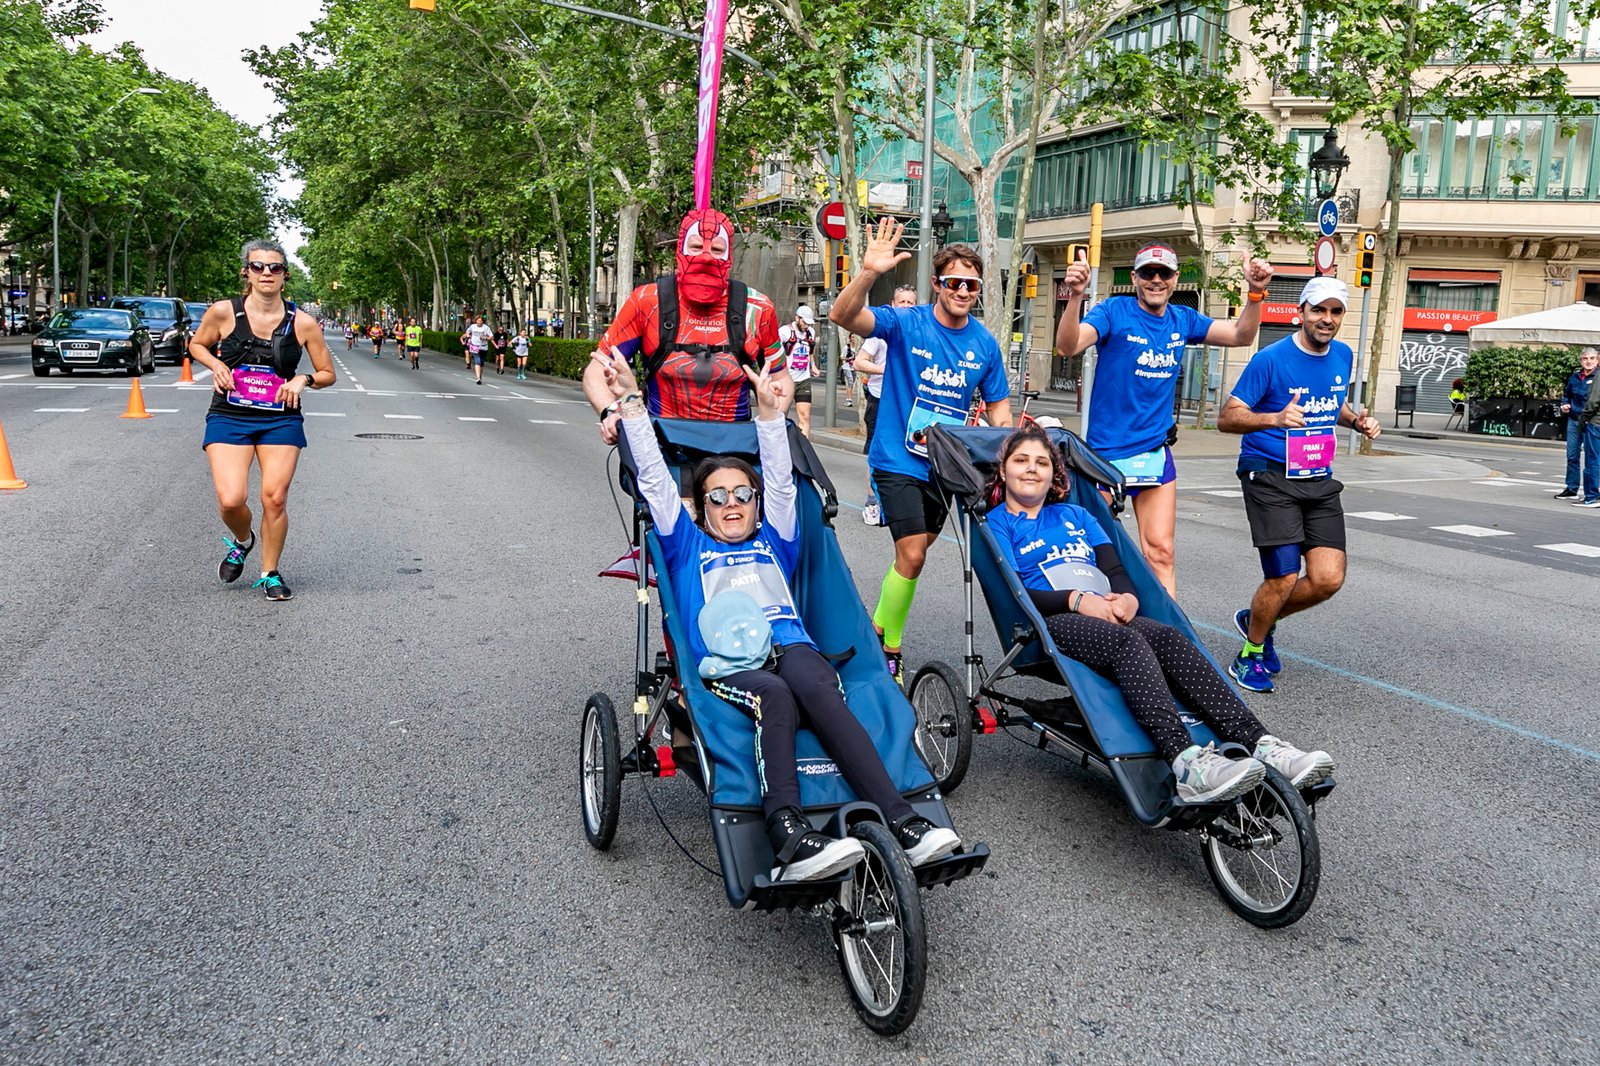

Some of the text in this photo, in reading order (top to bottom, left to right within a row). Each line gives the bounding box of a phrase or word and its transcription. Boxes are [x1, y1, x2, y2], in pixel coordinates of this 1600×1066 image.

[1267, 306, 1298, 314] PASSION
[1416, 311, 1451, 320] PASSION
[243, 377, 272, 386] MONICA
[918, 383, 962, 400] #imparables
[1303, 443, 1320, 452] FRAN
[1306, 453, 1322, 462] 1015
